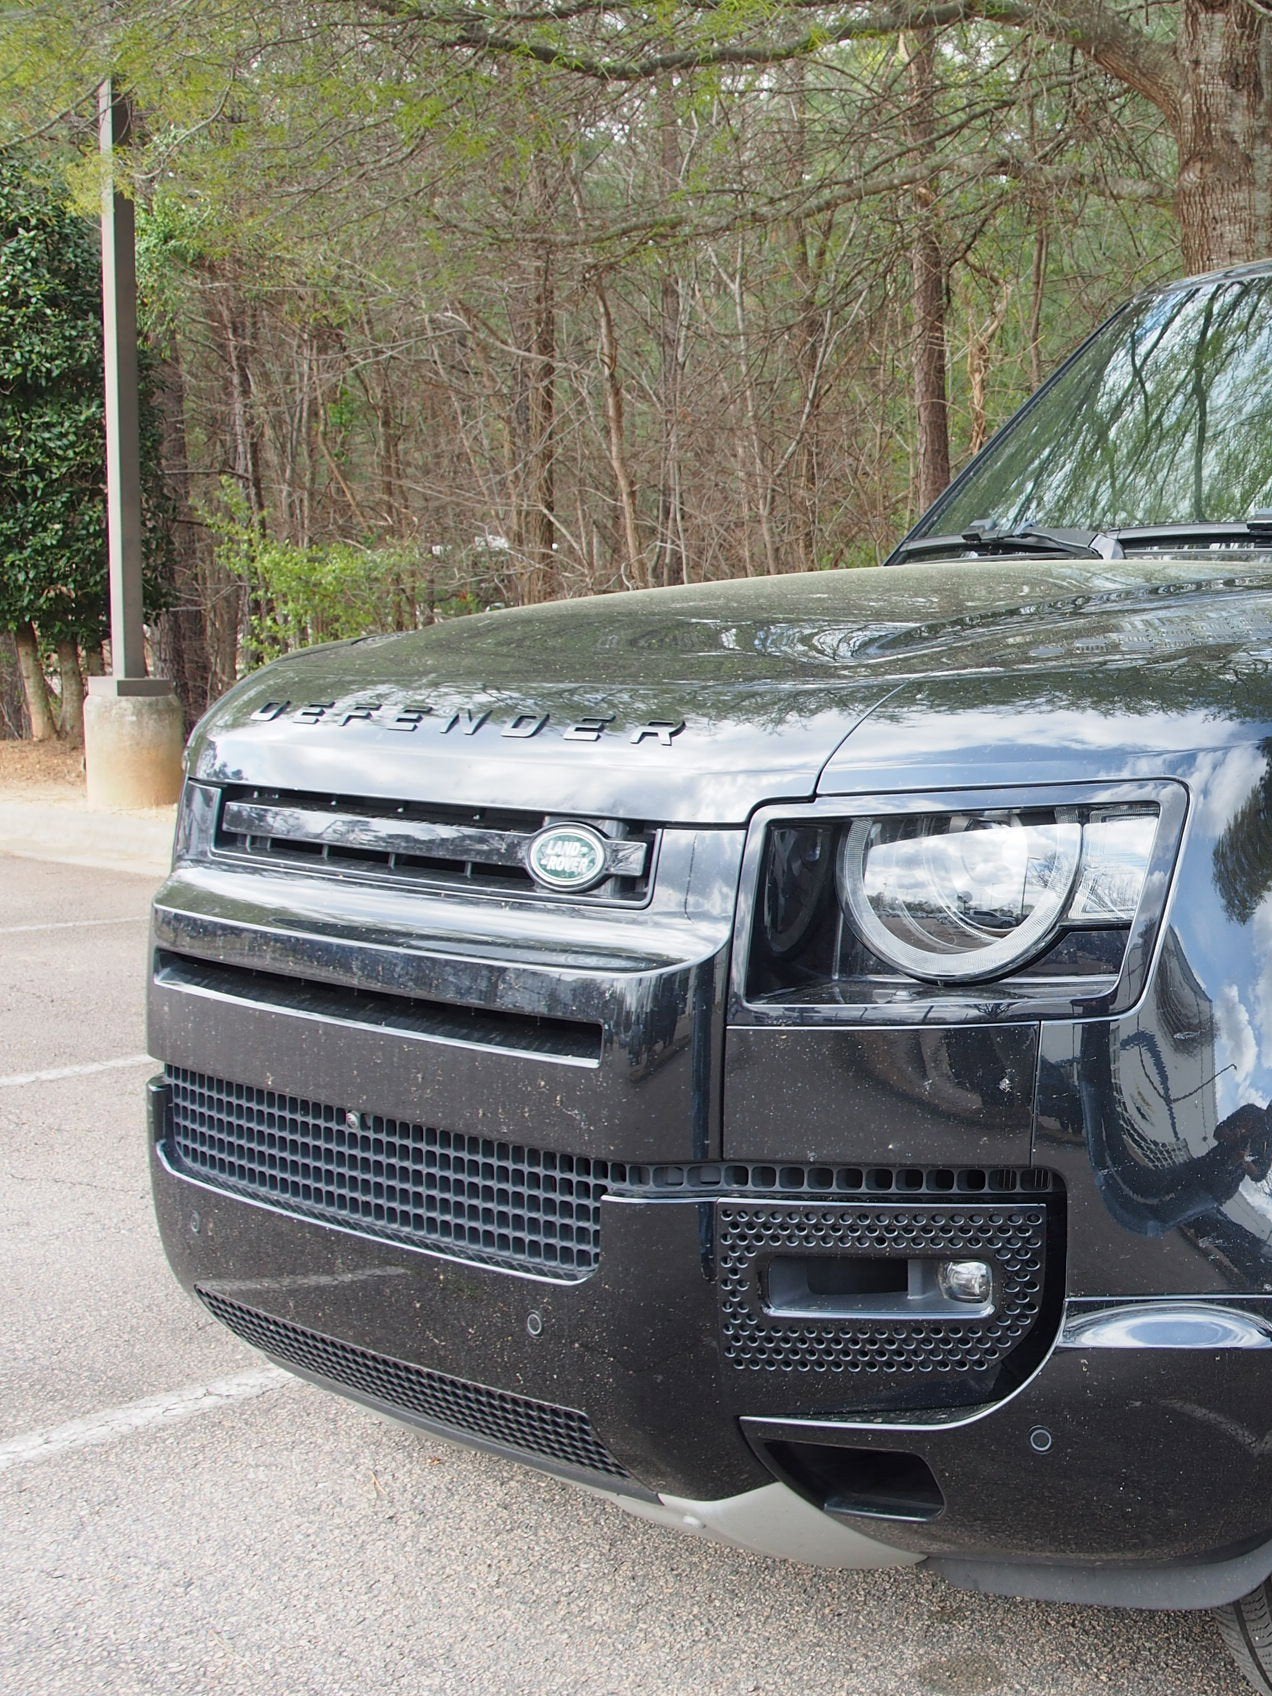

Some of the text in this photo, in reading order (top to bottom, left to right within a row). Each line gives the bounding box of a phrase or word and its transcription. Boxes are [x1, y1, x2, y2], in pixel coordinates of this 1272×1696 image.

[249, 699, 687, 746] DEFENDER
[546, 840, 581, 856] LAND
[546, 855, 590, 873] ROVER
